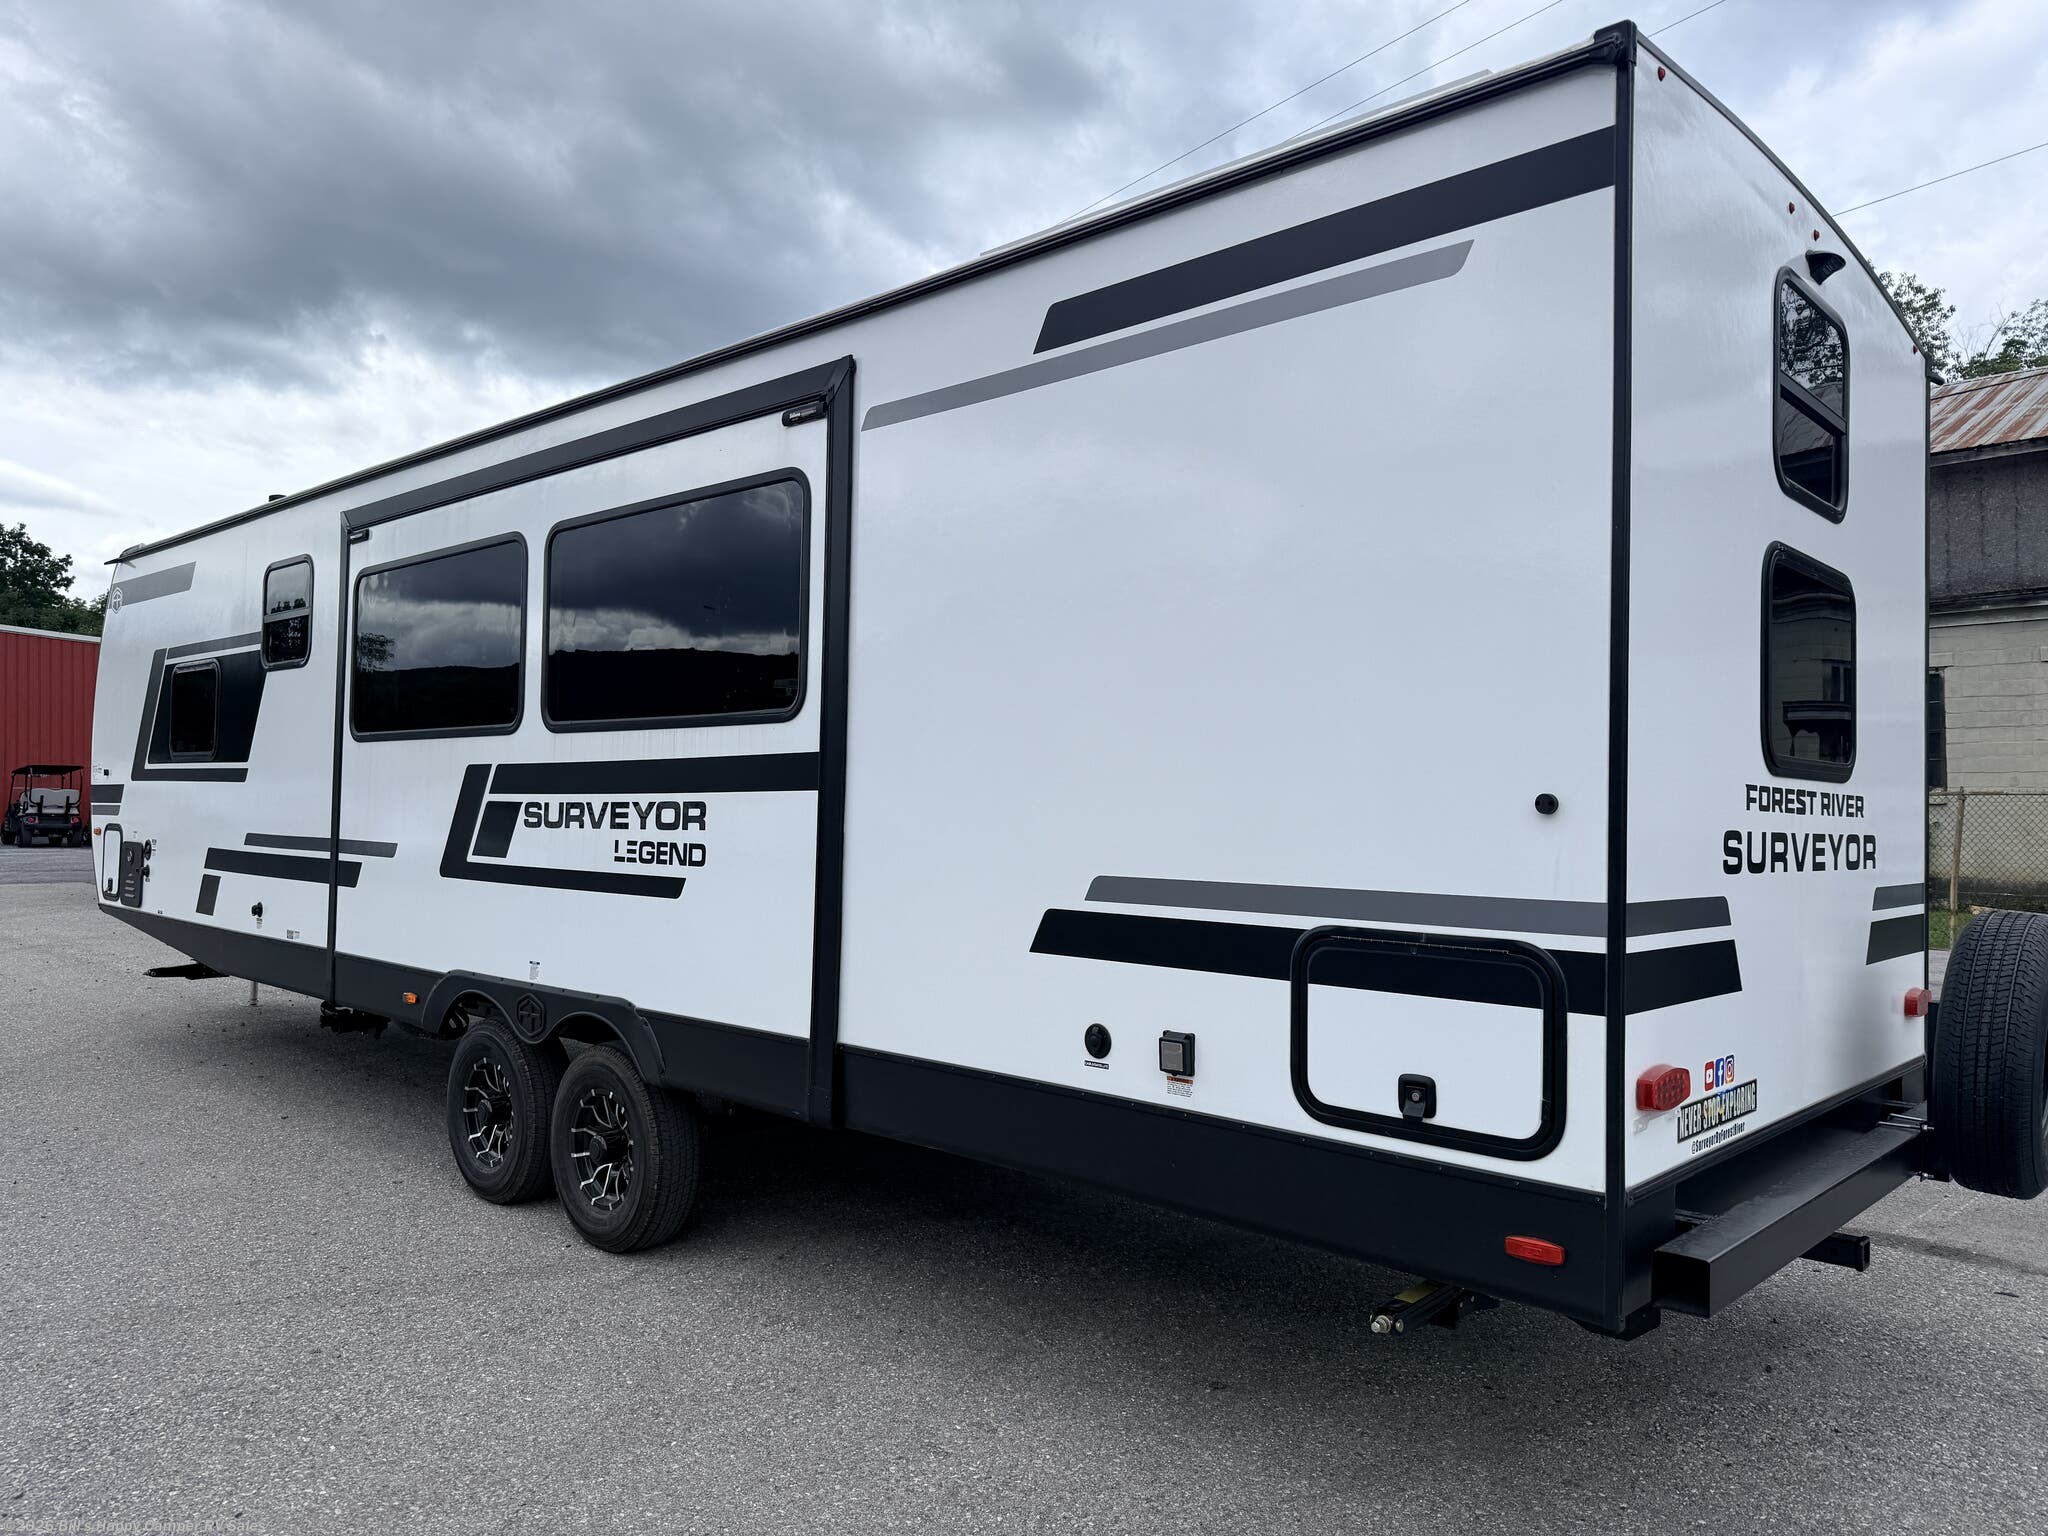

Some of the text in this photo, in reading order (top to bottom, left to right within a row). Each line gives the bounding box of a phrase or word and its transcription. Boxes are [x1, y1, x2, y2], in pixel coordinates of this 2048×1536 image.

[523, 801, 706, 831] SURVEYOR
[1745, 783, 1865, 818] FOREST RIVER
[613, 839, 707, 868] LEGEND
[1722, 829, 1877, 875] SURVEYOR
[1679, 1103, 1702, 1140] NEVER
[1721, 1082, 1756, 1122] EXPLORING
